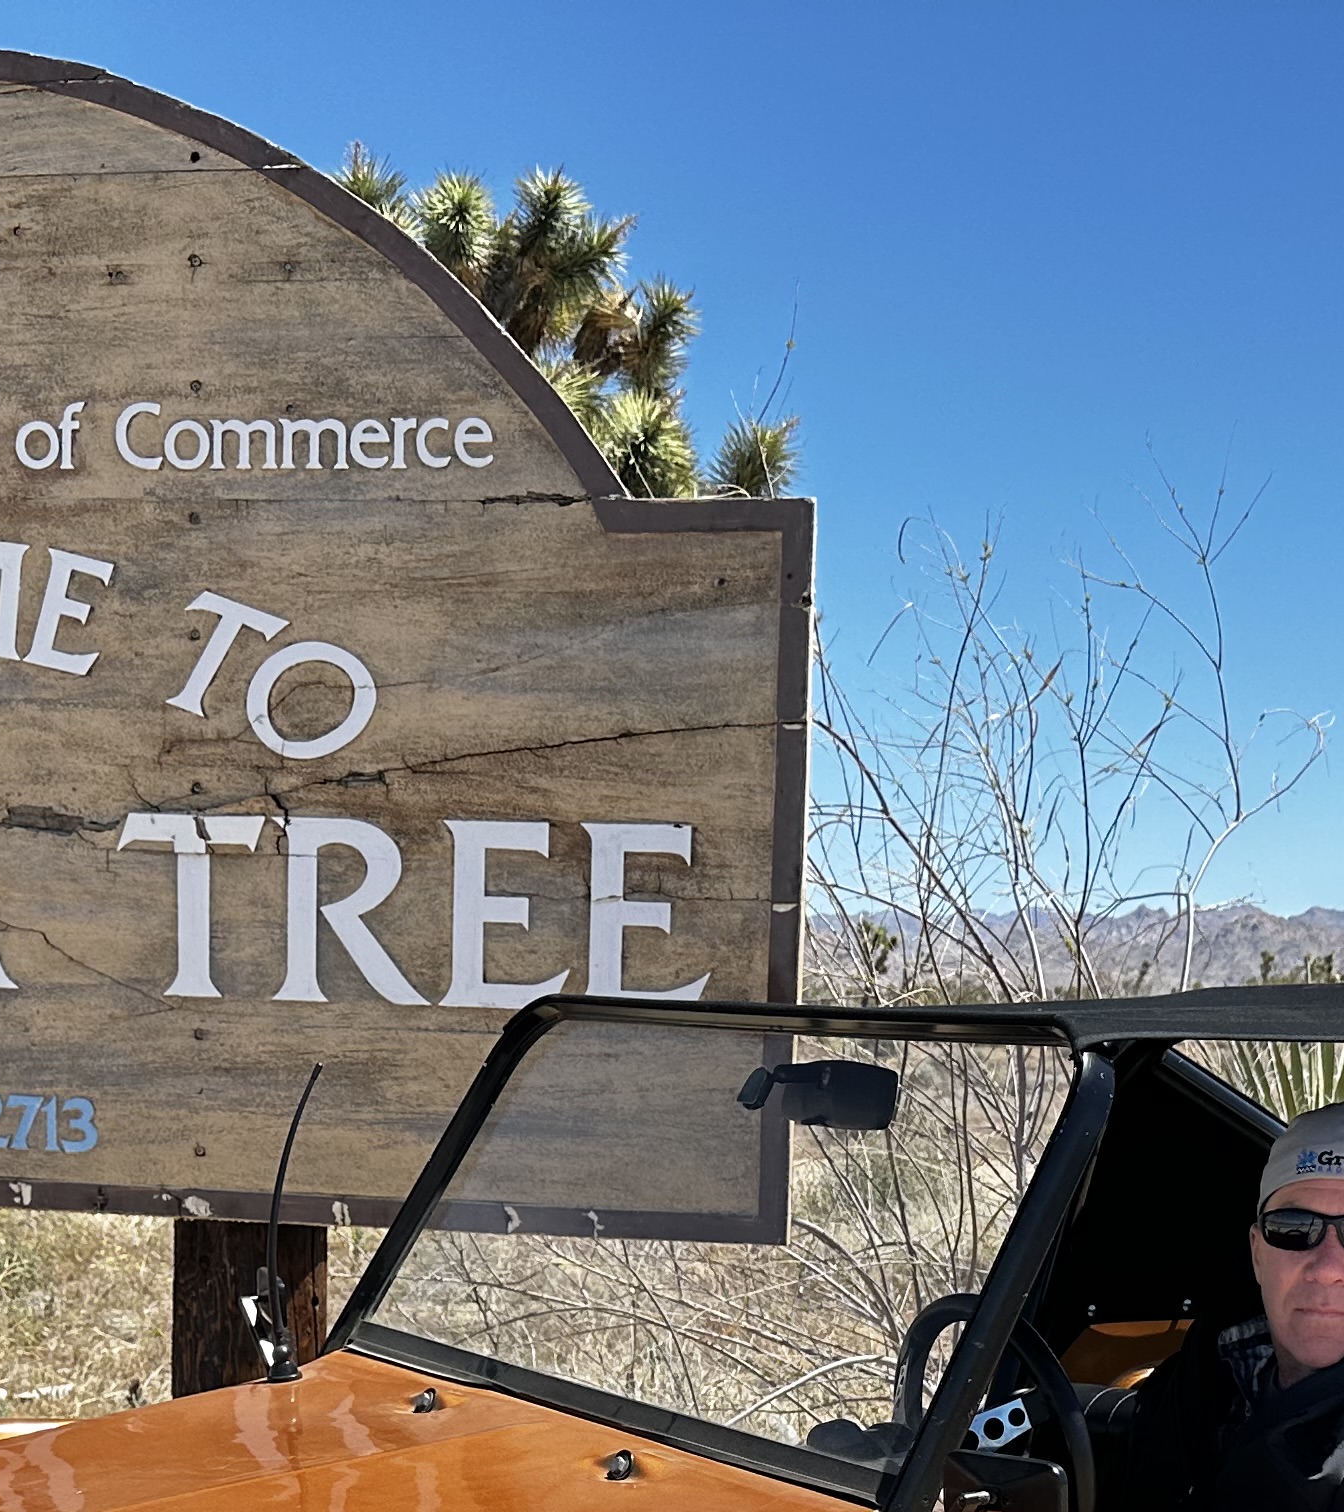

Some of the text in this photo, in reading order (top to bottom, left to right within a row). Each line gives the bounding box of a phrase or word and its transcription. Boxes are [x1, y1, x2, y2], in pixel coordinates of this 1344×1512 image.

[15, 401, 87, 471] of
[115, 402, 494, 471] Commerce
[165, 590, 378, 760] TO
[116, 812, 711, 1009] TREE
